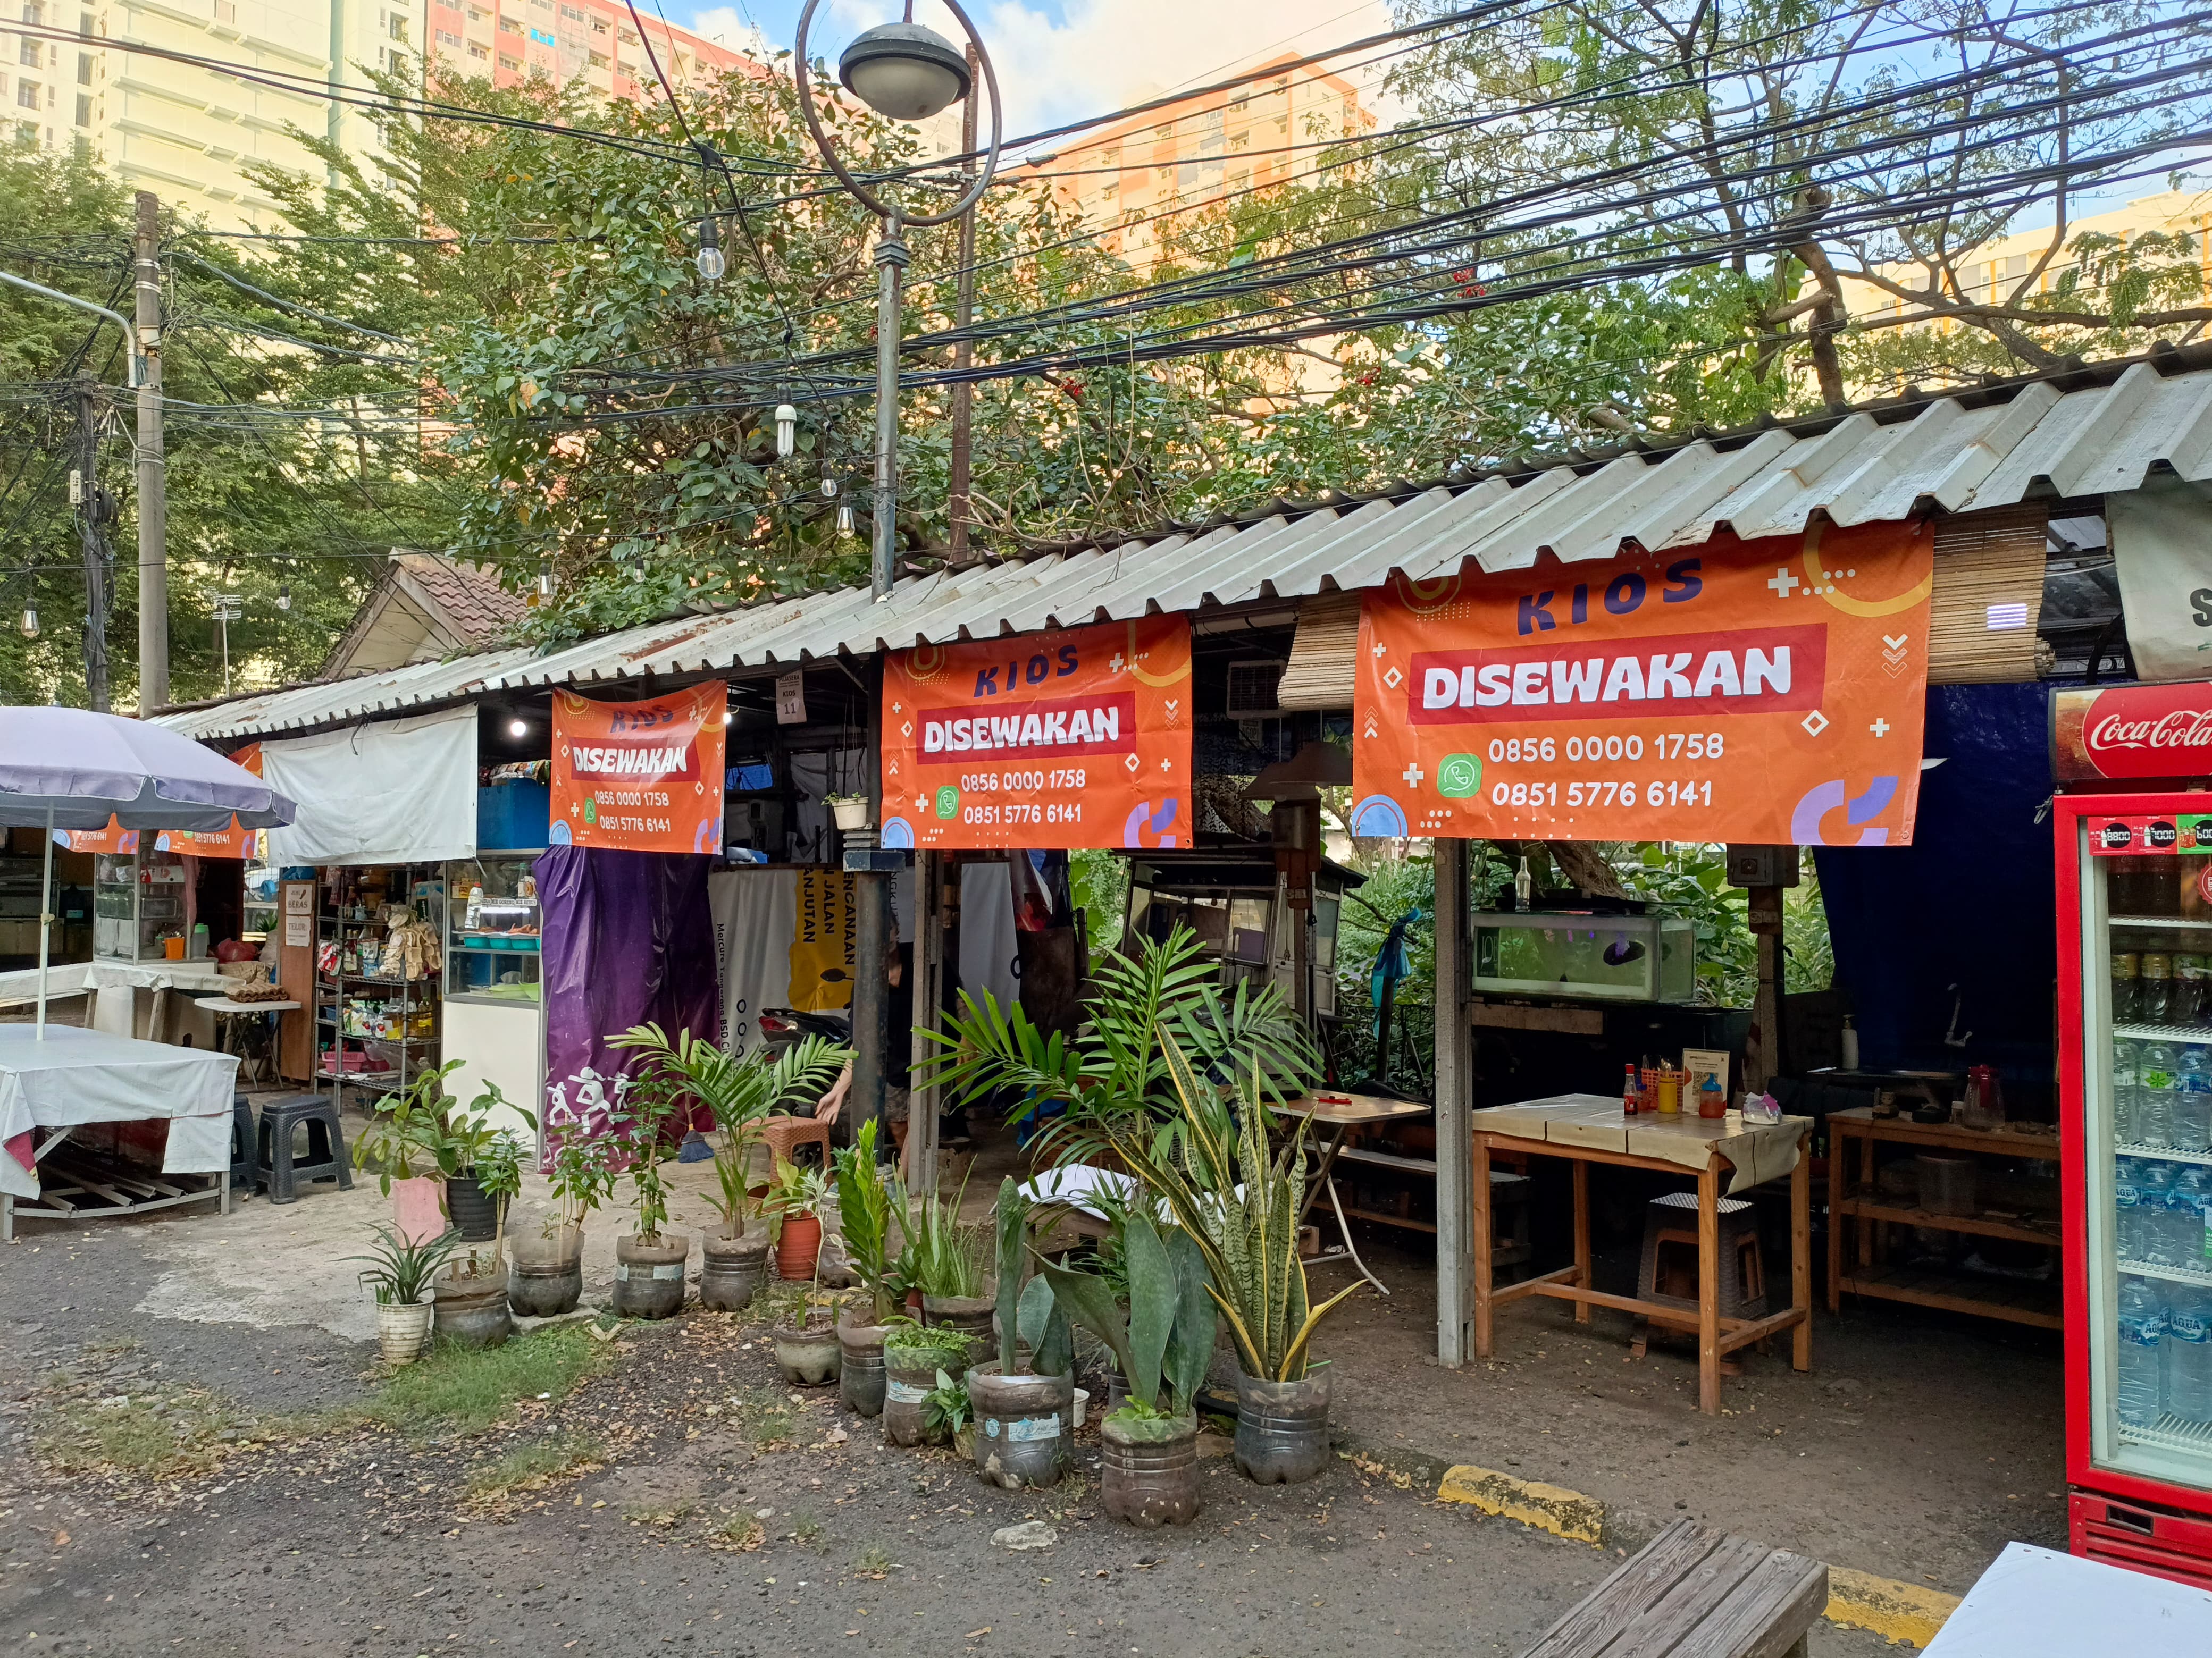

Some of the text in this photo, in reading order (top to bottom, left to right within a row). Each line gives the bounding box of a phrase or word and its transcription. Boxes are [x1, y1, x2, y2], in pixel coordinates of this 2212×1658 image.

[1518, 558, 1703, 636] KIOS
[974, 644, 1078, 697] KIOS
[1422, 646, 1791, 709] DISEWAKAN
[610, 705, 673, 733] KIOS
[784, 702, 796, 714] 11
[924, 706, 1118, 752] DISEWAKAN
[2090, 710, 2212, 750] Coca-Cola
[573, 746, 687, 773] DISEWAKAN
[1488, 733, 1724, 763] 0856 0000 1758
[961, 769, 1086, 792] 0856 0000 1758
[1492, 780, 1712, 807] 0851 5776 6141
[594, 790, 669, 806] 0856 0000 1758
[599, 815, 671, 832] 0851 5776 6141
[963, 803, 1081, 824] 0851 5776 6141
[203, 834, 215, 844] 5776
[215, 834, 230, 844] 6141
[803, 868, 816, 942] ANJUTAN
[823, 880, 835, 934] JALAN
[843, 872, 856, 965] ENCANAAN
[722, 1042, 730, 1056] Cit
[2173, 1316, 2201, 1330] AQUA
